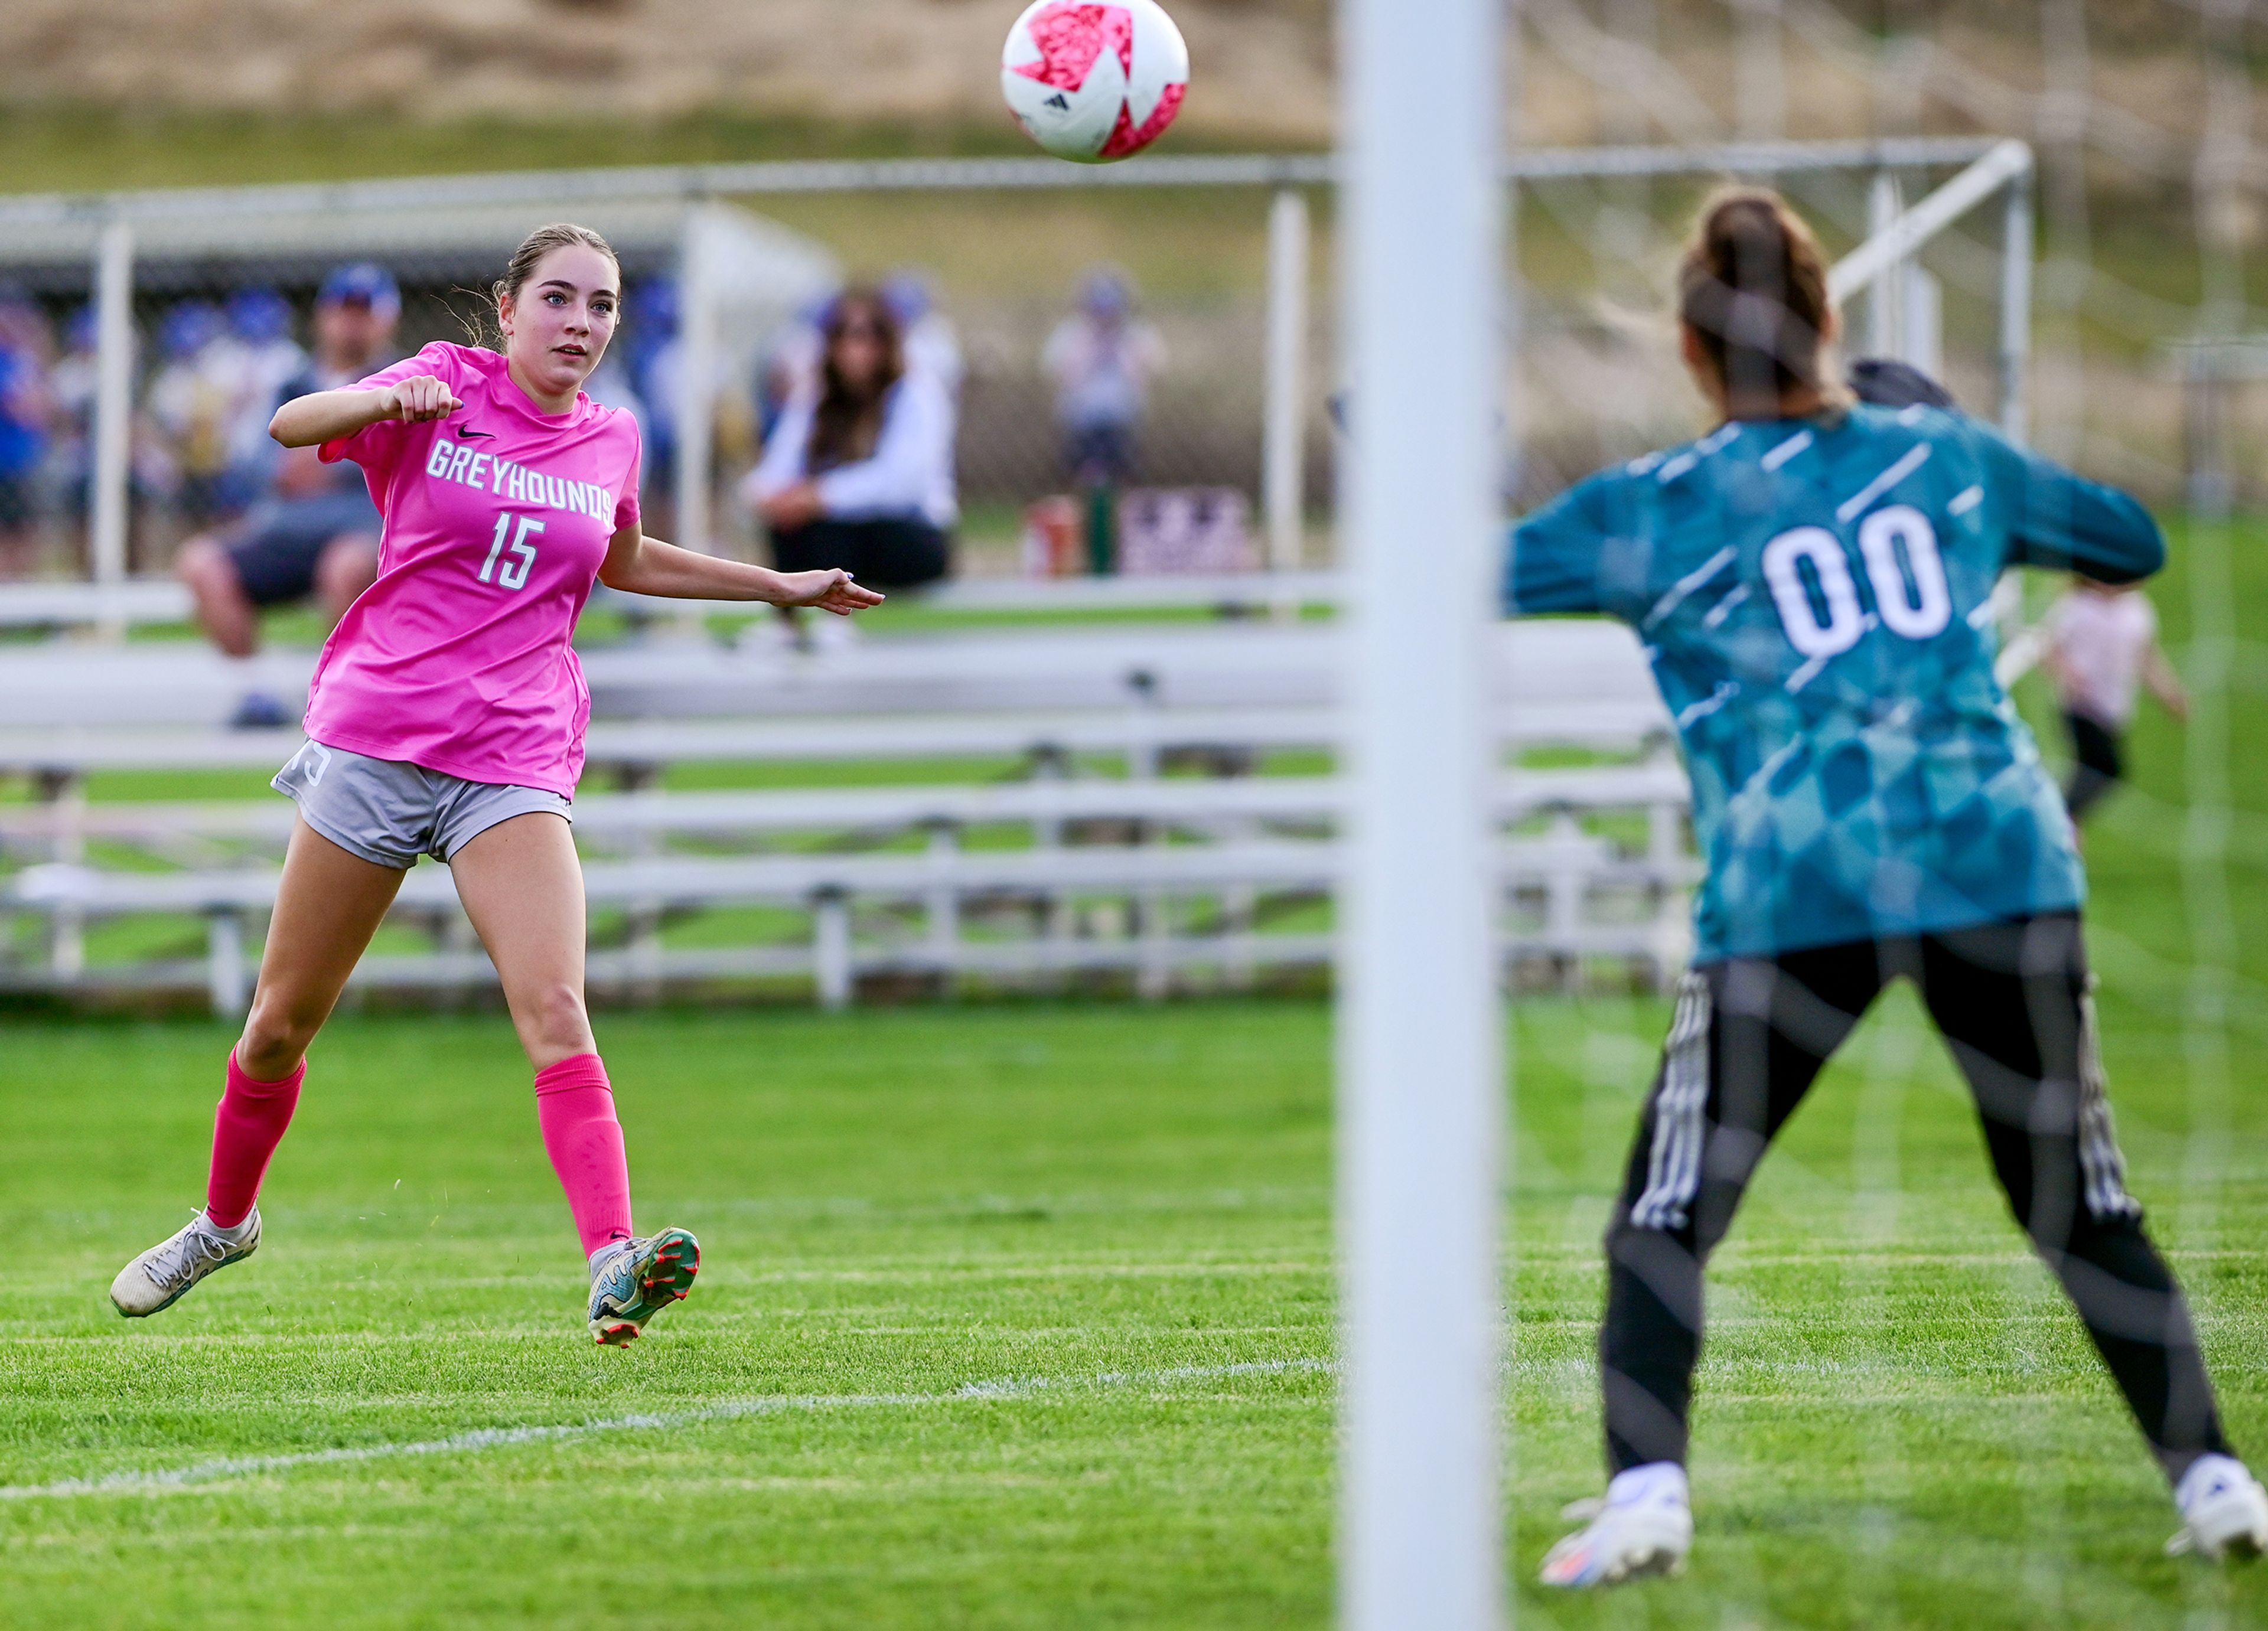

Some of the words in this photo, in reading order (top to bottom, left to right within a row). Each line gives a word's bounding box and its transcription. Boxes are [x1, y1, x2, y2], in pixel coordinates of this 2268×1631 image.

[426, 438, 612, 522] GREYHOUNDS
[477, 511, 546, 590] 15
[1762, 503, 1951, 658] 00
